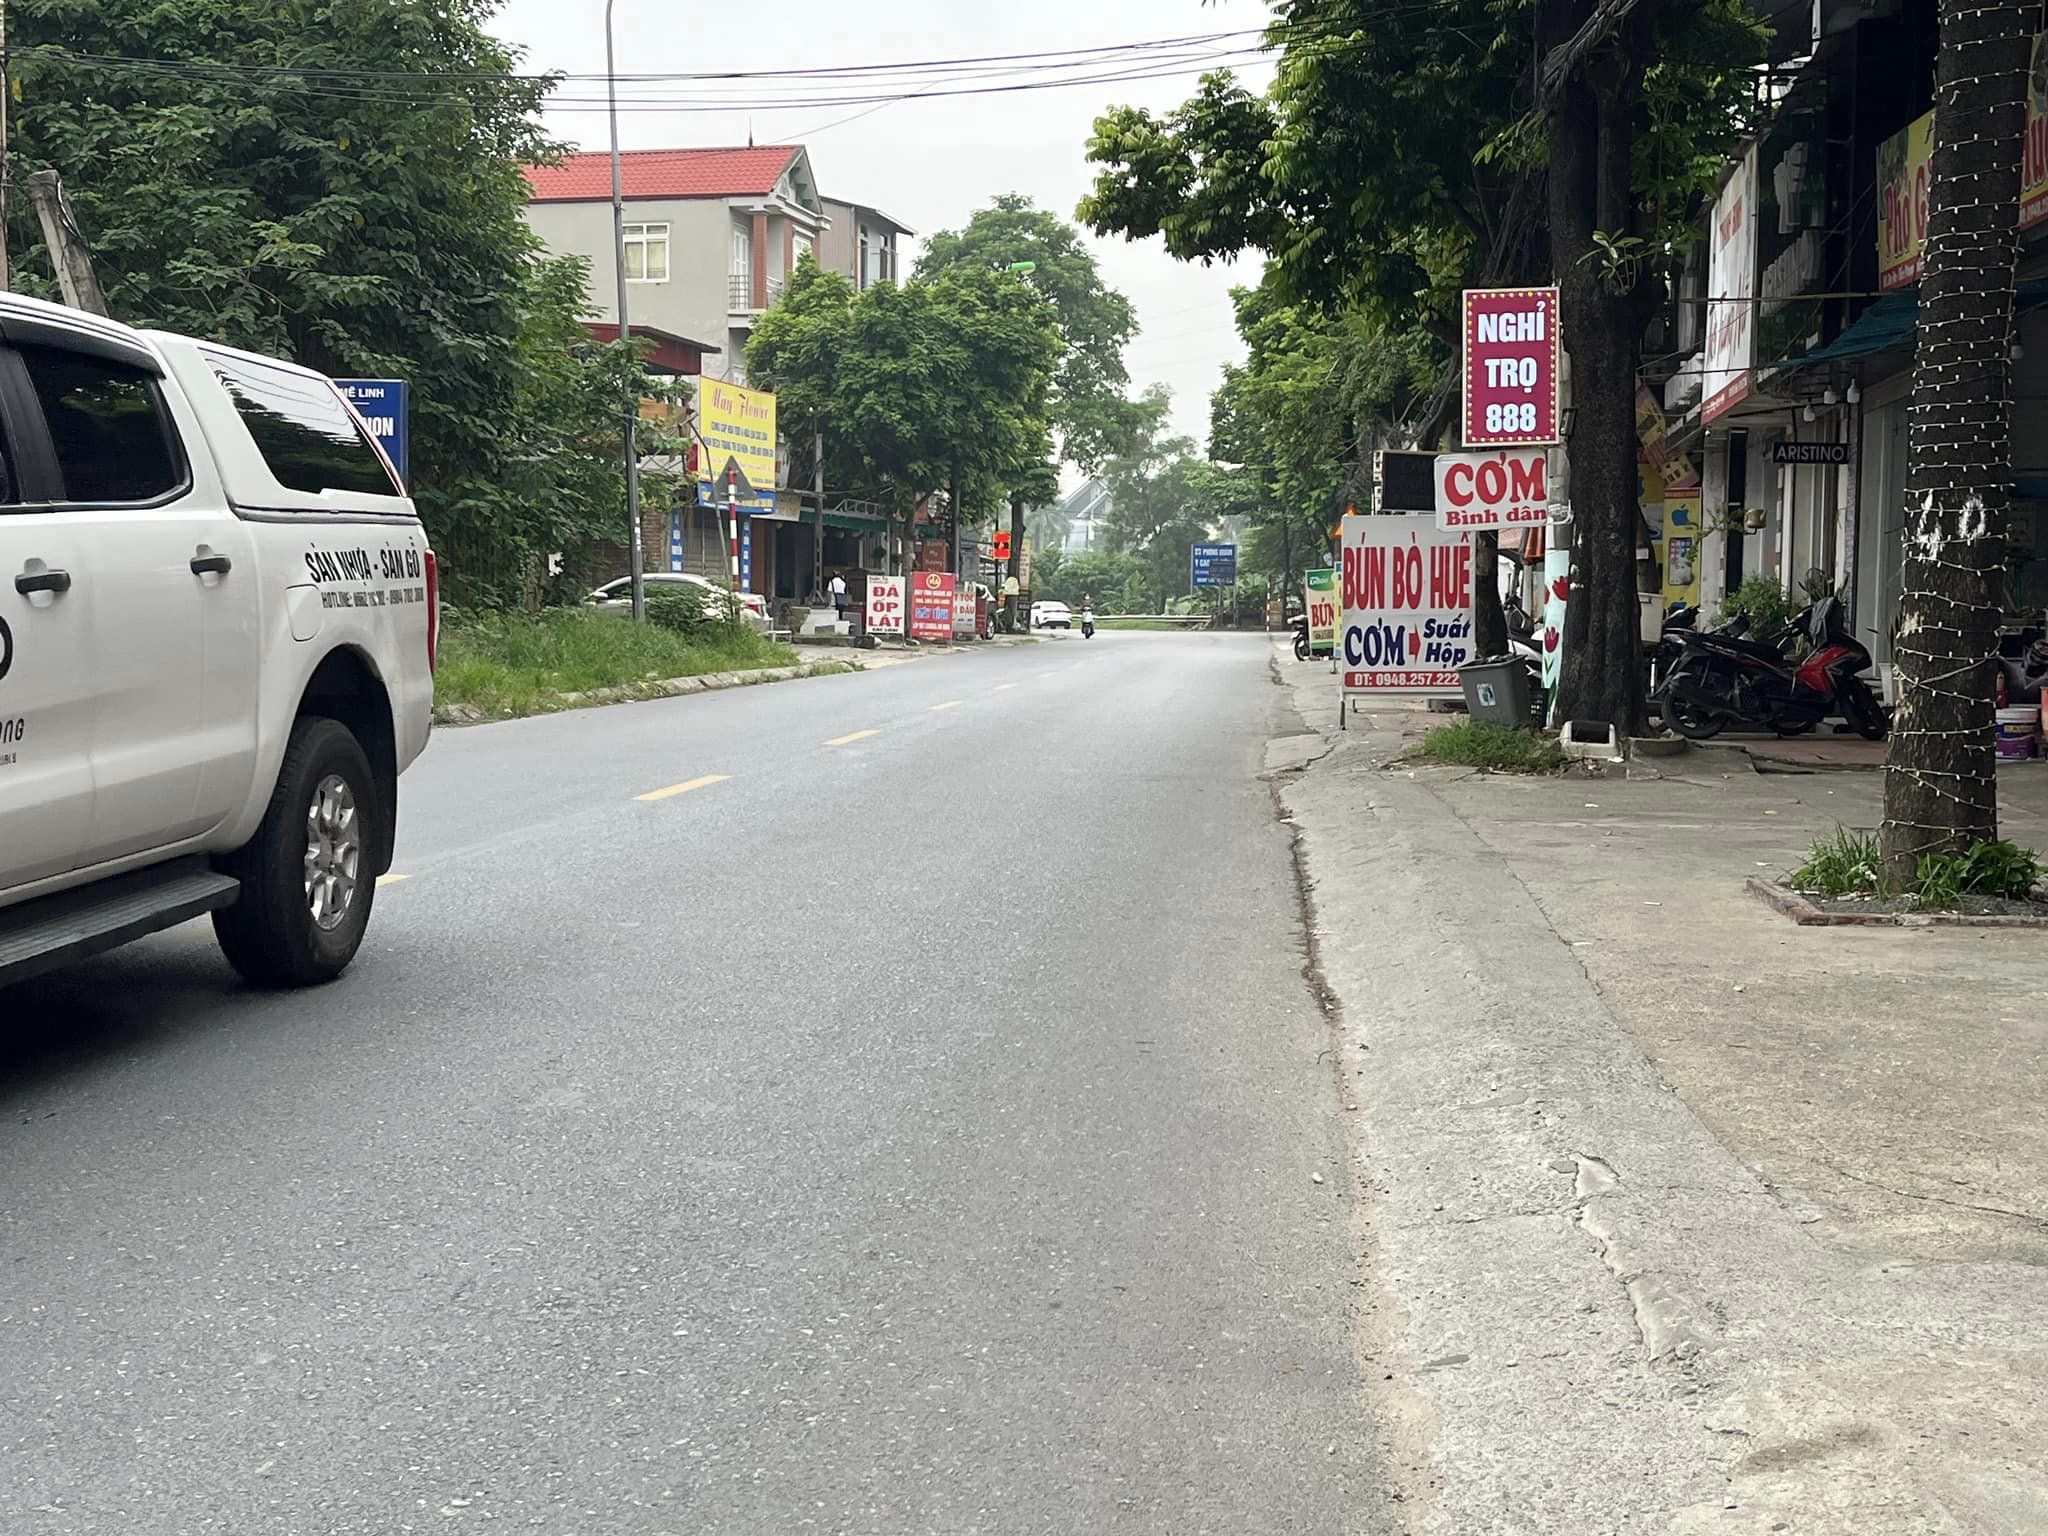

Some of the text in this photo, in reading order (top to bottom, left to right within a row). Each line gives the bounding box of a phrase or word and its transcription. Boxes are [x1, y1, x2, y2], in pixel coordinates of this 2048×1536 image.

[1477, 301, 1546, 343] NGHỈ
[1484, 357, 1537, 393] TRỌ
[358, 388, 385, 398] LINH
[1486, 402, 1537, 433] 888
[1776, 445, 1844, 461] ARISTINO
[1444, 452, 1547, 507] CƠM
[1445, 506, 1547, 526] Bình dân
[305, 542, 342, 583] SÀN
[335, 547, 373, 586] NHỰA
[380, 541, 405, 579] SÀN
[405, 536, 420, 578] GỖ
[1343, 532, 1386, 610] BÚN
[1392, 532, 1423, 610] BÒ
[872, 584, 899, 597] ĐÁ
[872, 598, 899, 612] ỐP
[868, 614, 903, 627] LÁT
[1423, 613, 1471, 639] Suất
[1344, 617, 1406, 667] CƠM
[1425, 641, 1467, 669] Hộp
[1375, 673, 1460, 686] 0948.257.222
